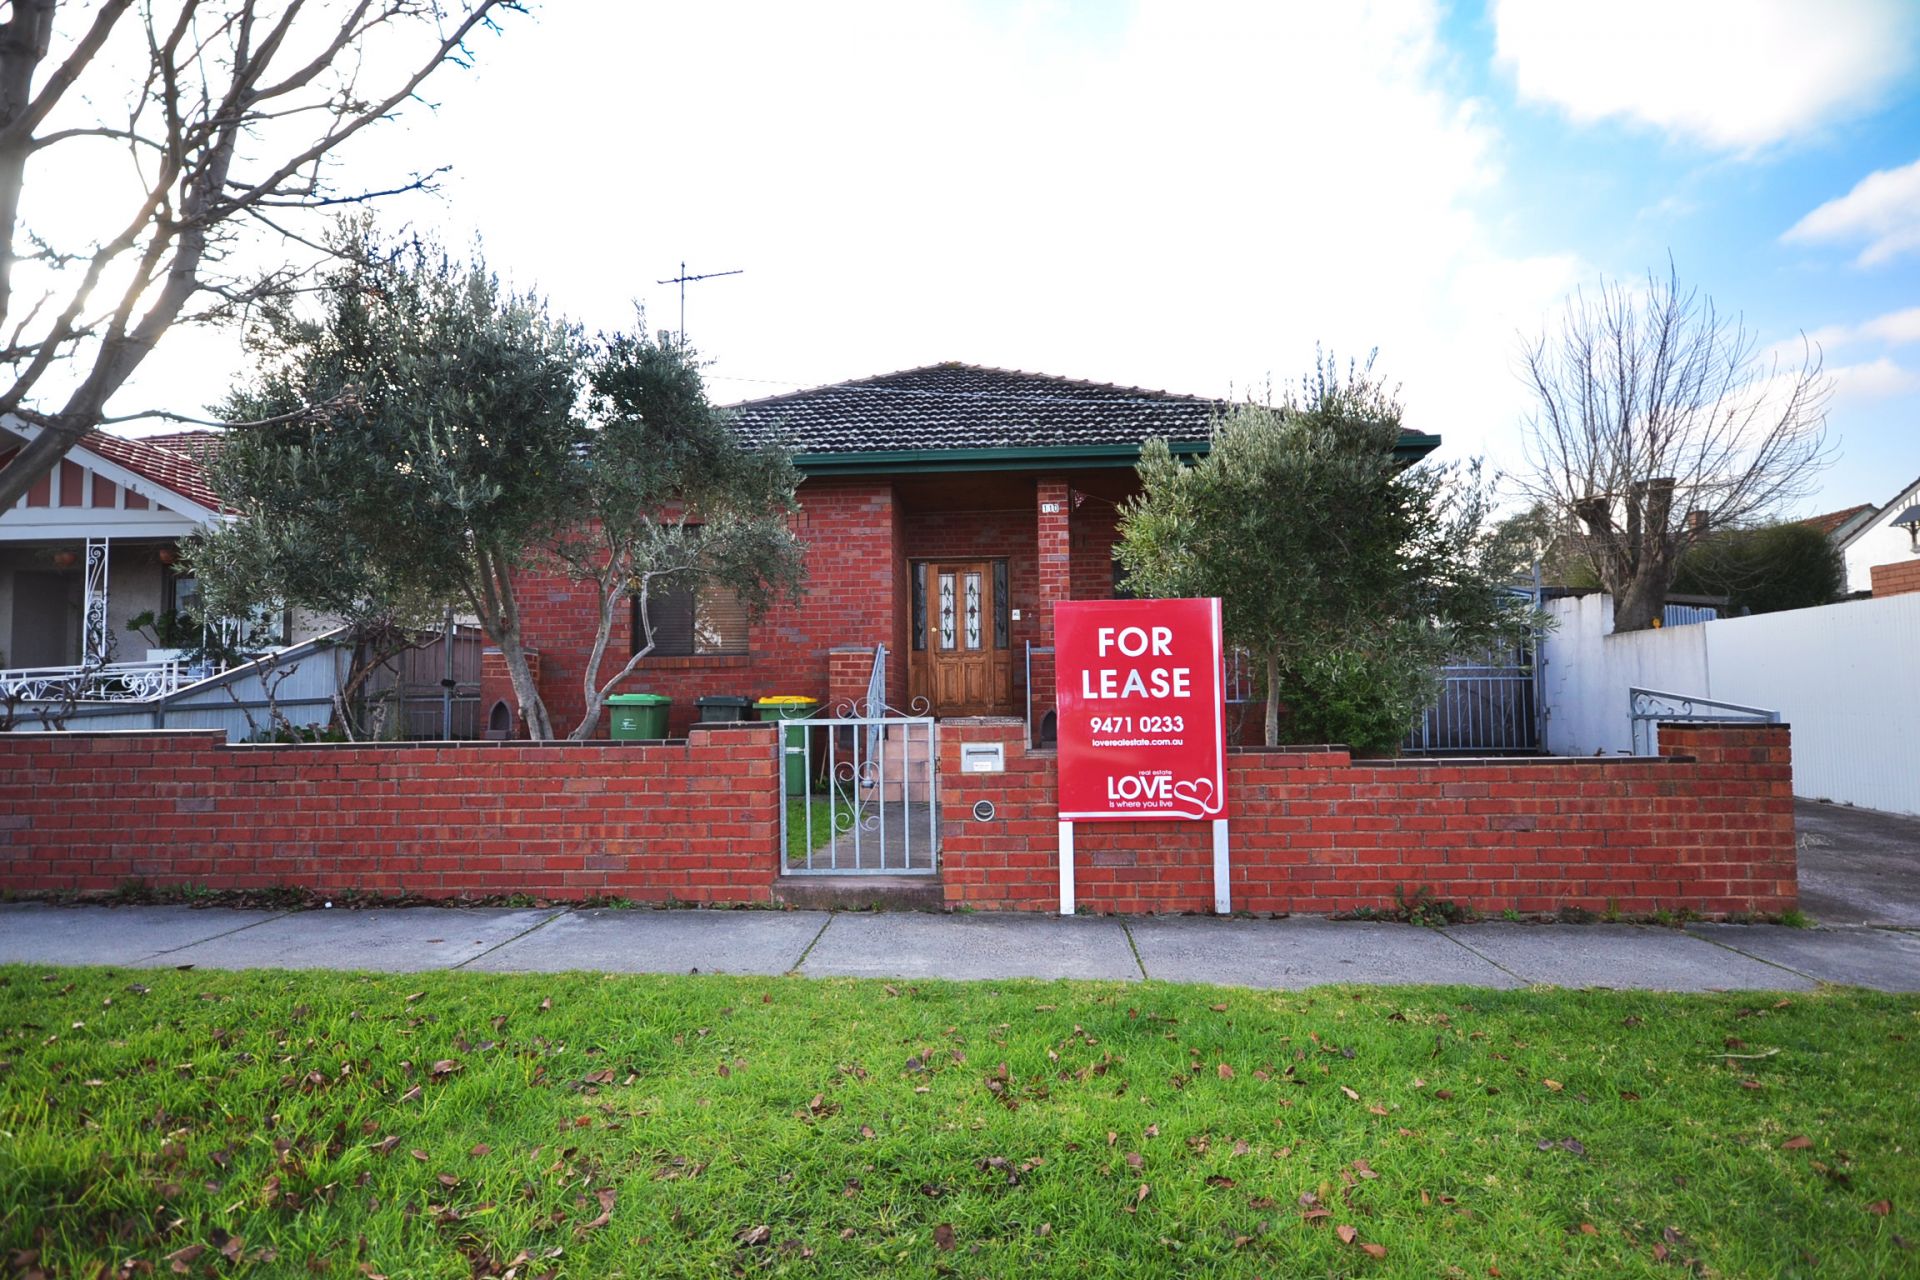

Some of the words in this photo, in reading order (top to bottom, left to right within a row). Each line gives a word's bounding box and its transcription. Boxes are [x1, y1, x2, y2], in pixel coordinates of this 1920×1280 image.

[1098, 626, 1173, 657] FOR
[1082, 668, 1191, 699] LEASE
[1090, 716, 1132, 734] 9471
[1139, 715, 1184, 733] 0233
[1092, 738, 1184, 747] loverealestate.com.au
[1107, 775, 1173, 800] LOVE
[1116, 800, 1141, 808] where
[1142, 801, 1158, 809] you
[1159, 800, 1173, 808] live
